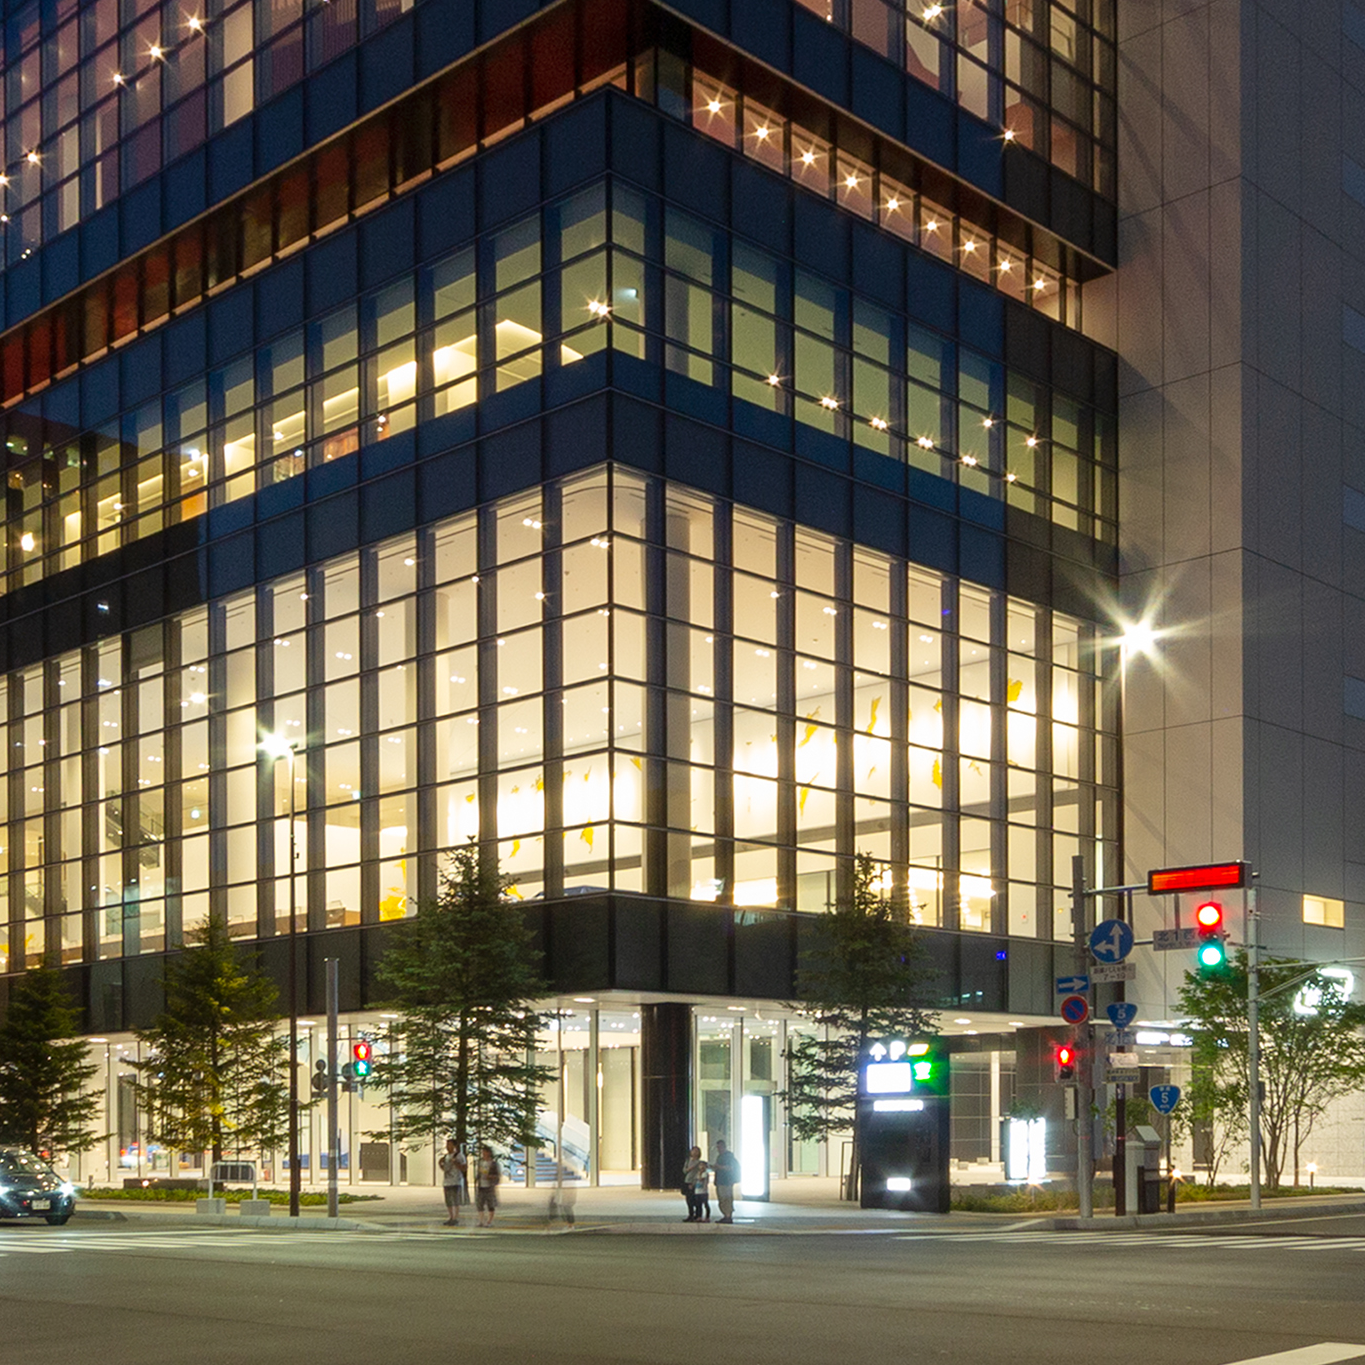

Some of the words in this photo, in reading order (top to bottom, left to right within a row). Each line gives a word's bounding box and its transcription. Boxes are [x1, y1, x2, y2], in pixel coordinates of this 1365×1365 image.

[1117, 1008, 1126, 1019] 5
[890, 1040, 906, 1062] P
[1161, 1092, 1169, 1104] 5
